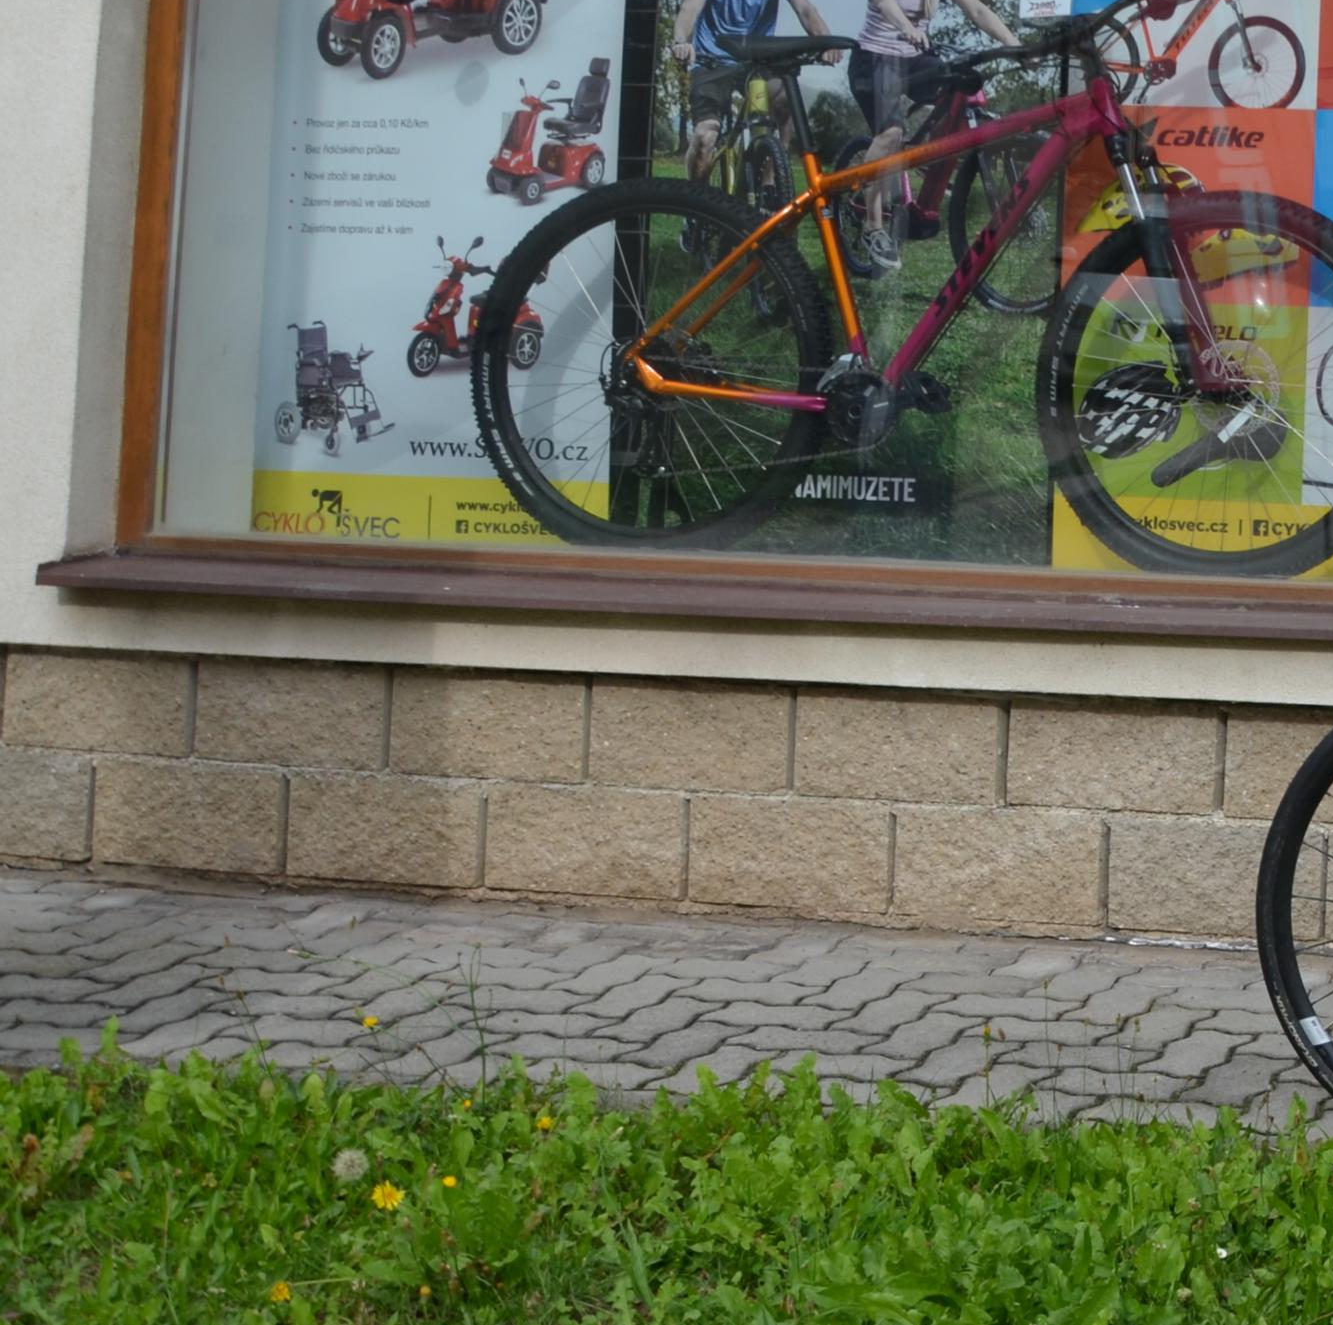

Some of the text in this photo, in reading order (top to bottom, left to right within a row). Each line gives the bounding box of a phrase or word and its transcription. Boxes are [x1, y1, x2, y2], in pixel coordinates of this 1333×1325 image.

[1156, 125, 1265, 149] catlike
[254, 508, 401, 539] CYKLO ŠVEC
